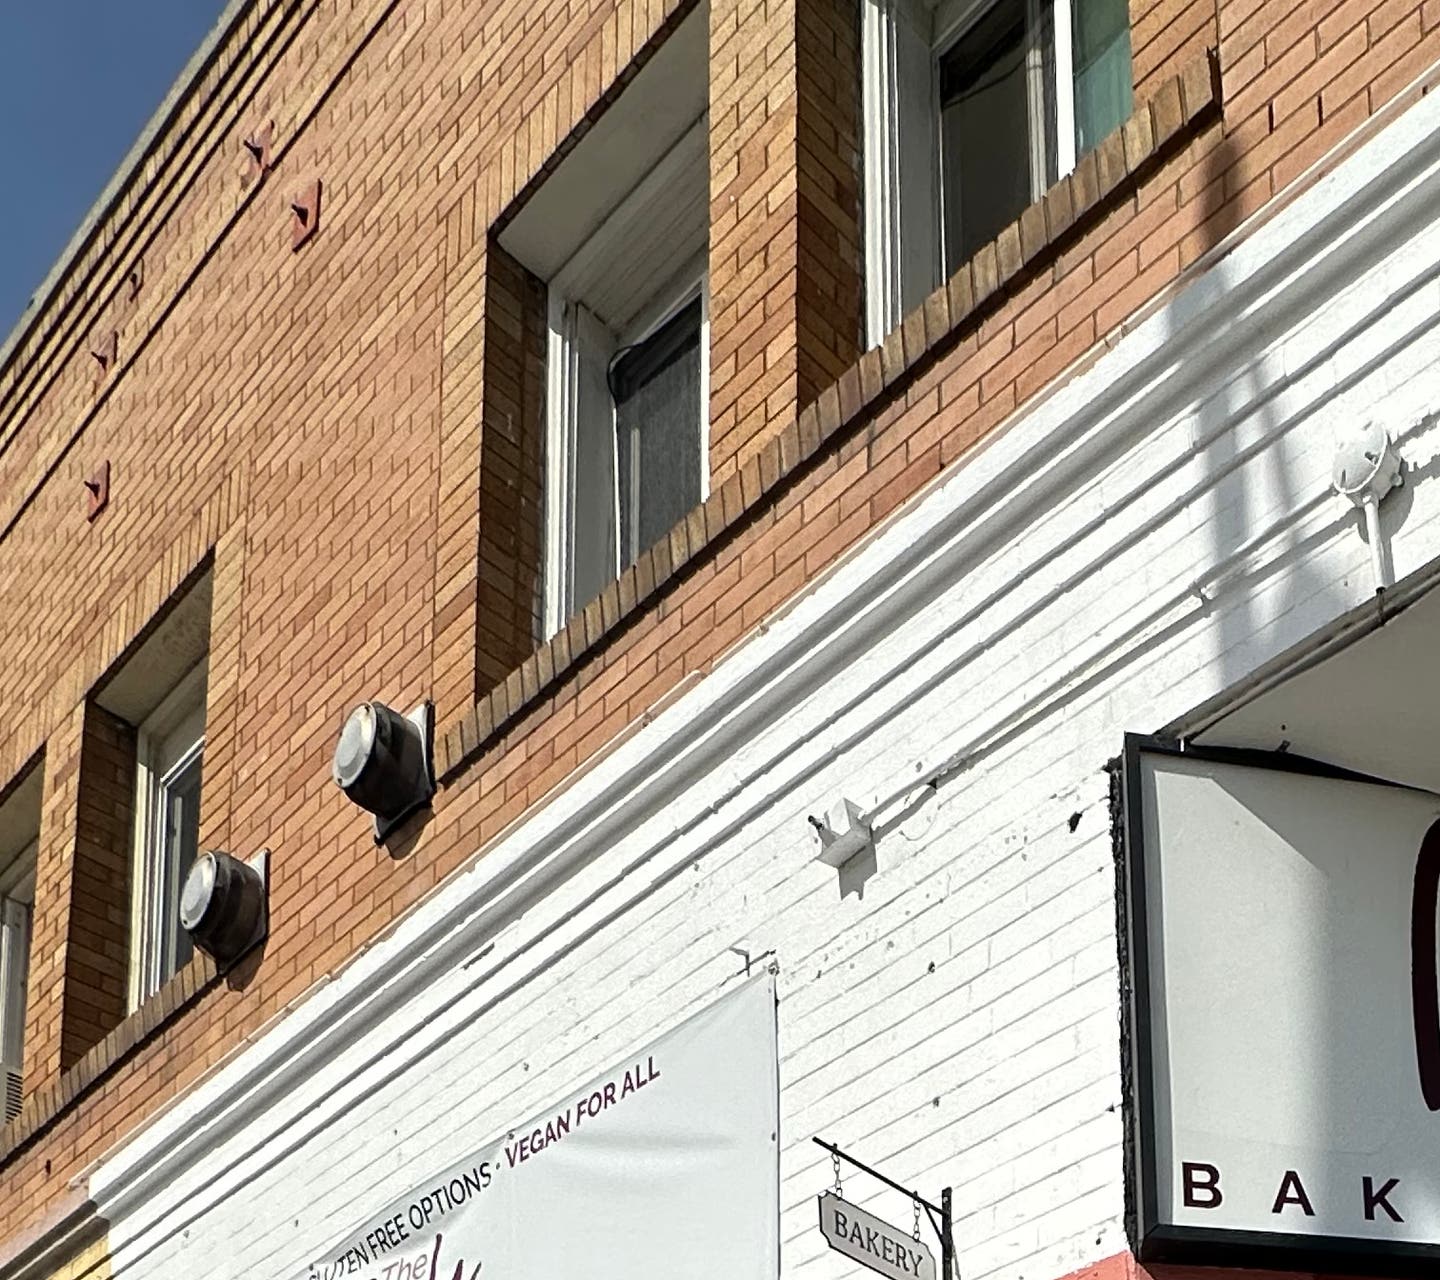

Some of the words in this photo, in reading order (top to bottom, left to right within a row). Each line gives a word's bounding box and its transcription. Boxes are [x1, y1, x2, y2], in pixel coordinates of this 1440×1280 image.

[368, 1214, 409, 1259] FREE
[409, 1162, 492, 1230] OPTIONS
[505, 1110, 571, 1168] VEGAN
[576, 1081, 616, 1127] FOR
[622, 1056, 660, 1099] ALL
[834, 1209, 923, 1278] BAKERY
